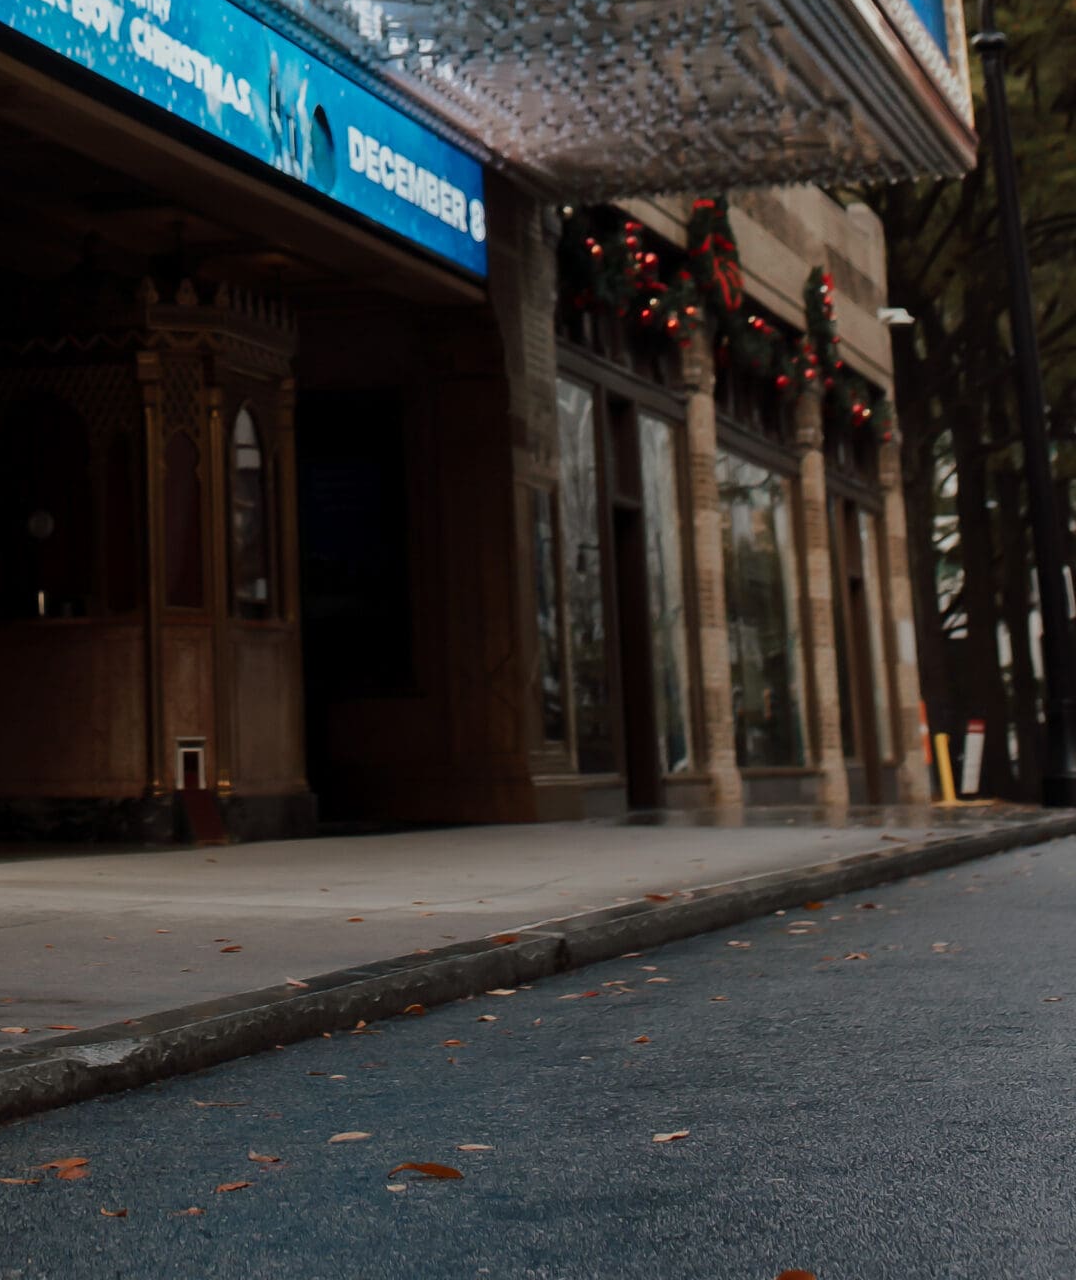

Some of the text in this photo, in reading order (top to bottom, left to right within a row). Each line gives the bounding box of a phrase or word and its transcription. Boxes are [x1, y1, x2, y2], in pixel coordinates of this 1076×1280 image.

[130, 17, 253, 116] CHRISTMAS
[347, 125, 487, 243] DECEMBER 8
